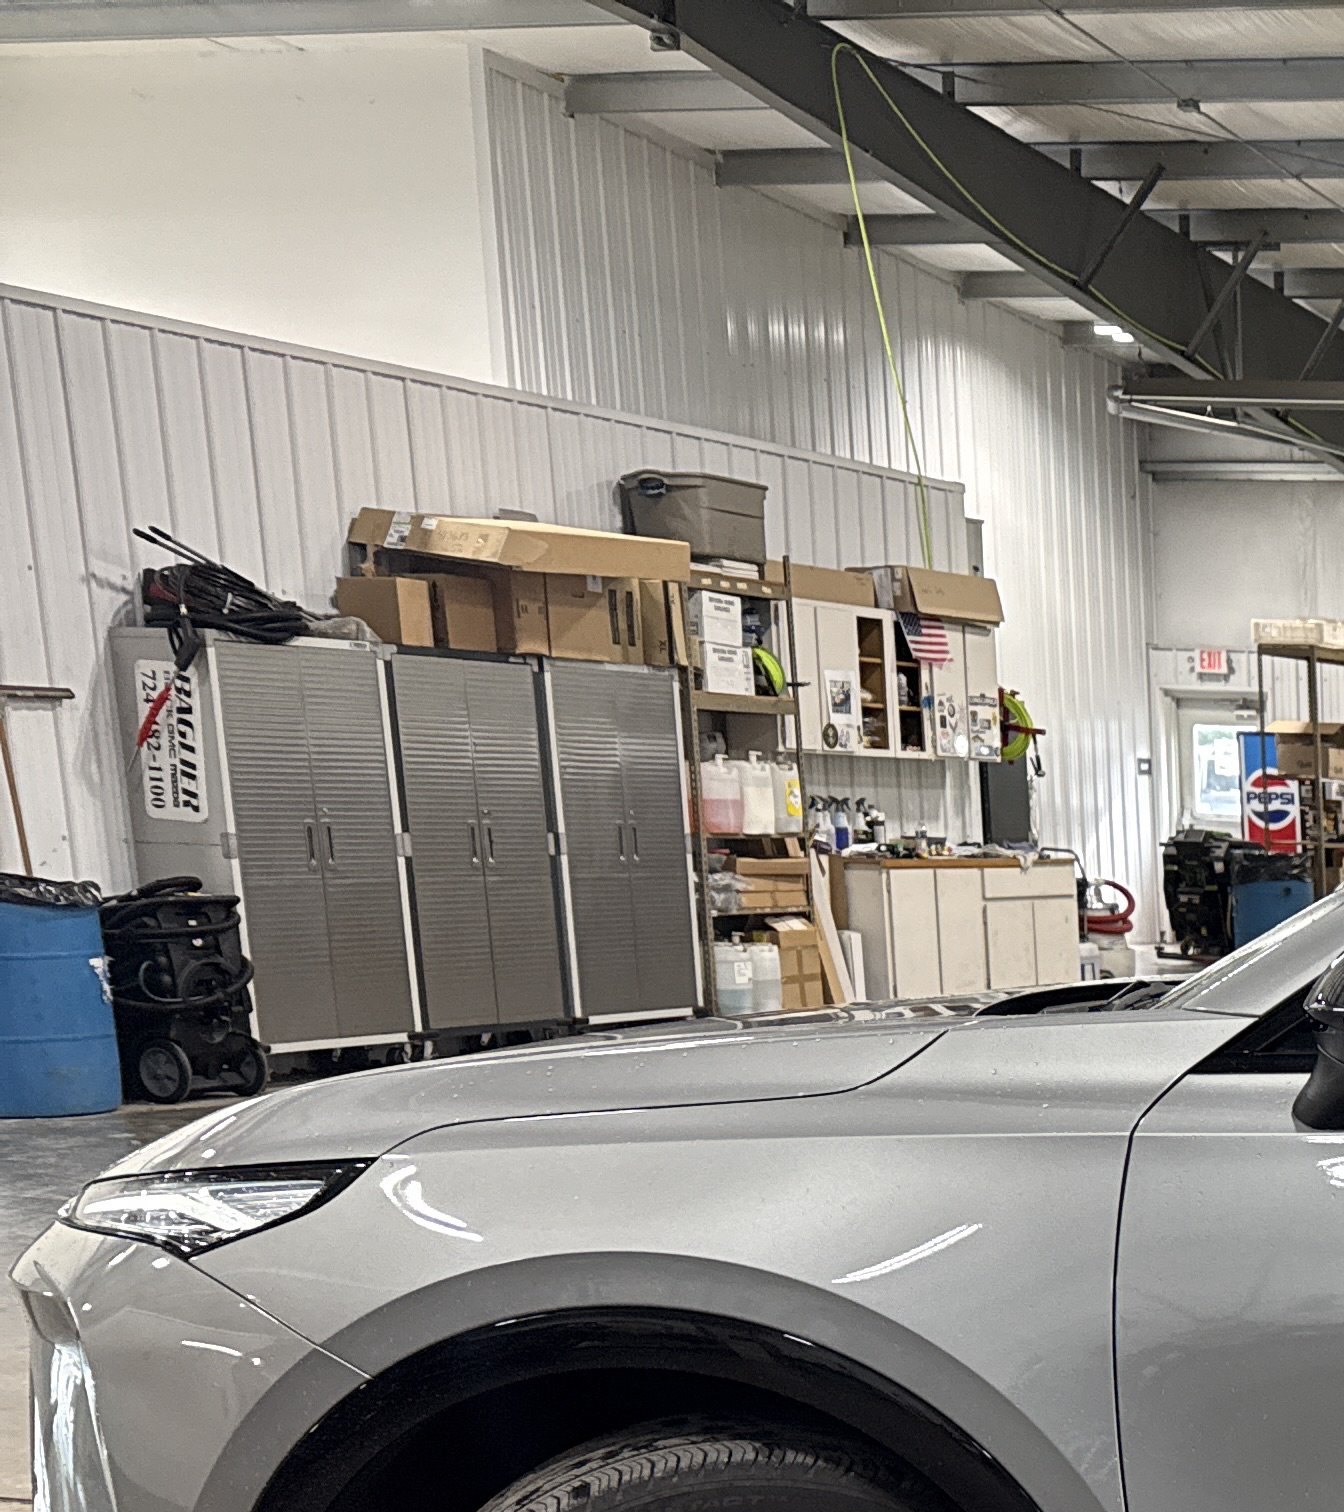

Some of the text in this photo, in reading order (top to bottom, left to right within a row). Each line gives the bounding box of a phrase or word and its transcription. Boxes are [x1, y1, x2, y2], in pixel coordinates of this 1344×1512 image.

[1200, 650, 1222, 670] EXIT
[167, 723, 177, 759] GMC
[174, 672, 200, 813] BAGLIER
[170, 763, 180, 808] mazda
[1246, 791, 1295, 805] PEPSI
